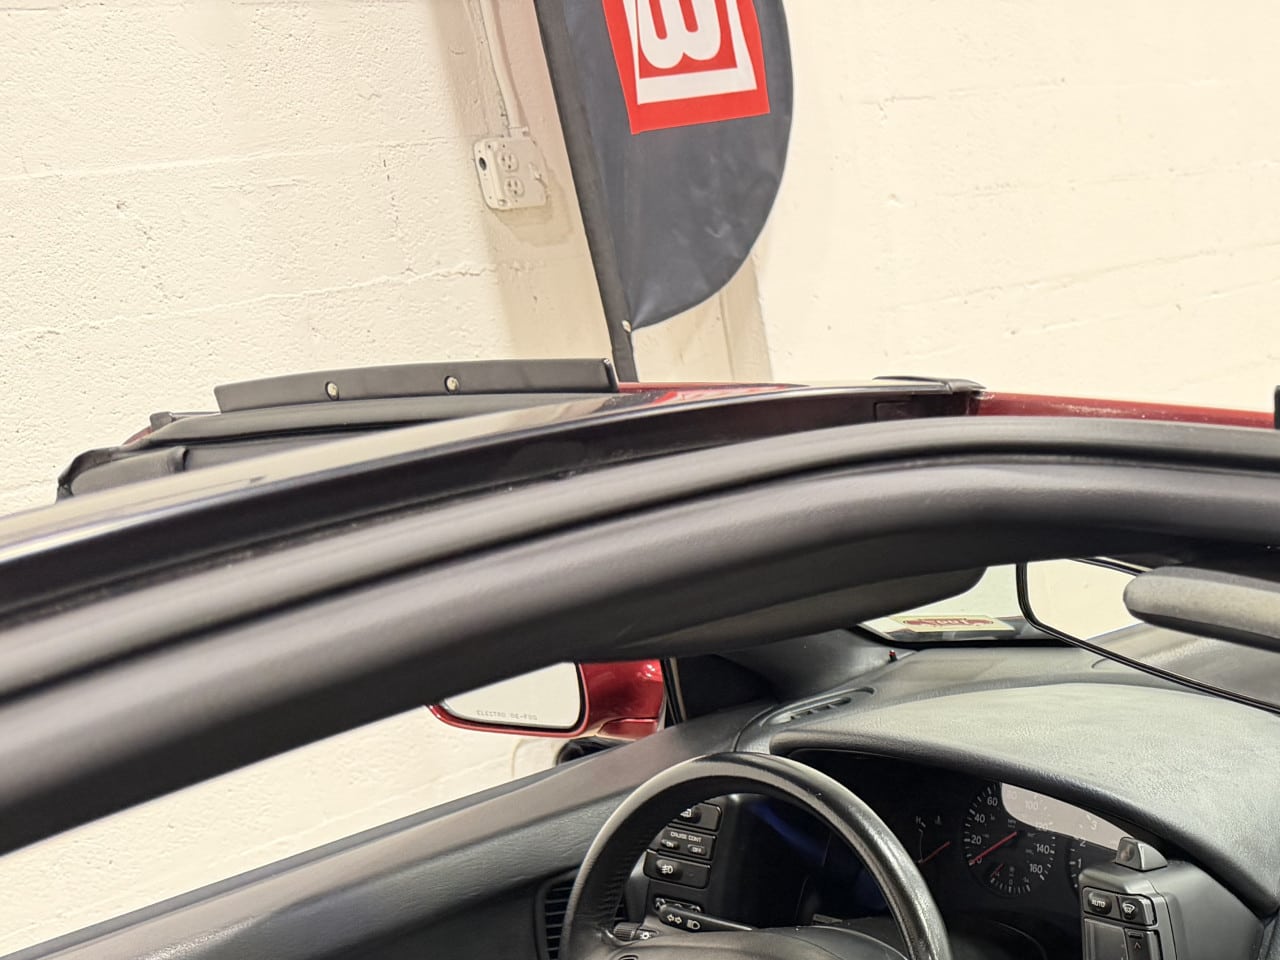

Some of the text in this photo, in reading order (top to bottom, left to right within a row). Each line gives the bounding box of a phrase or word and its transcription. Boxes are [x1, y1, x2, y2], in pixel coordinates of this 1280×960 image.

[987, 796, 998, 807] 60
[1025, 800, 1039, 811] 100
[974, 813, 986, 823] 40
[670, 831, 687, 840] CRUISE
[971, 834, 982, 846] 20
[1036, 844, 1050, 855] 140
[1029, 863, 1043, 874] 160
[1091, 899, 1106, 908] AUTO
